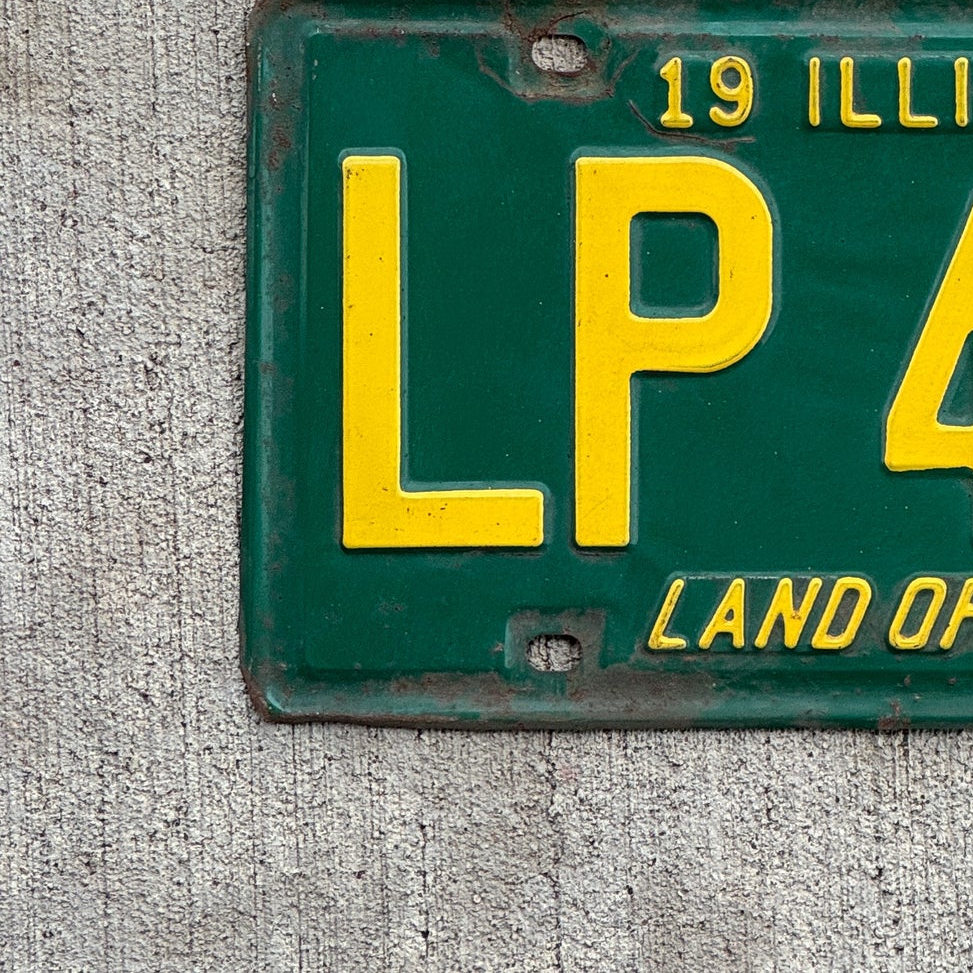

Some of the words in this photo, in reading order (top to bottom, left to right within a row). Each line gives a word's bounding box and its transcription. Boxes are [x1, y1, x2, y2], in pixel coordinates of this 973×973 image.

[658, 56, 755, 130] 19
[341, 155, 775, 549] LP
[646, 575, 873, 651] LAND
